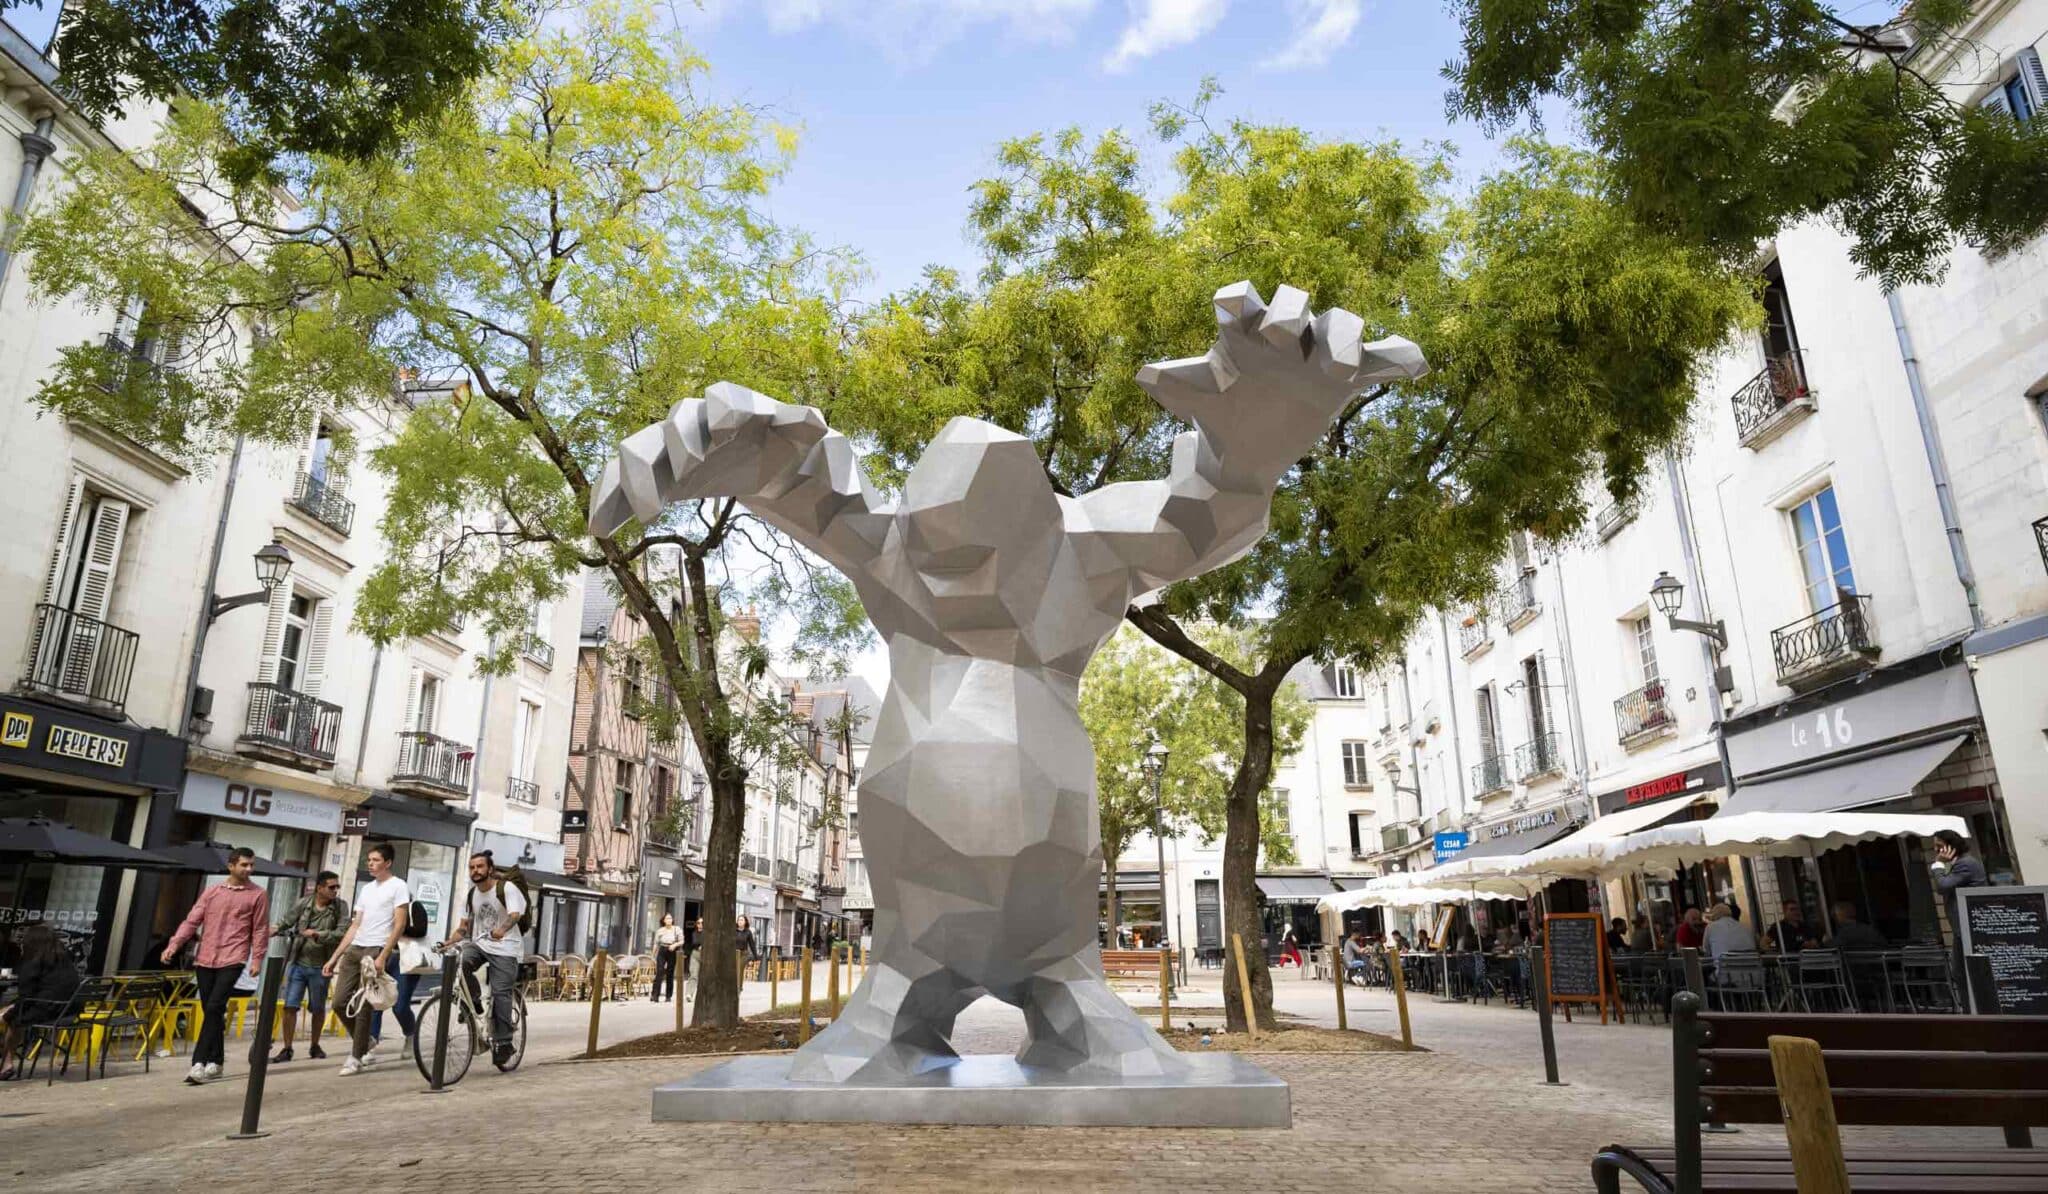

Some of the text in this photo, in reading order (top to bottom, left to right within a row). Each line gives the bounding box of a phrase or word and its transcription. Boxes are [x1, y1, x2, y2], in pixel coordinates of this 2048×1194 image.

[1816, 707, 1852, 748] 16
[49, 729, 127, 765] PEPPERS!
[225, 783, 273, 817] QG
[345, 818, 368, 827] QG
[1442, 840, 1460, 849] CESAR
